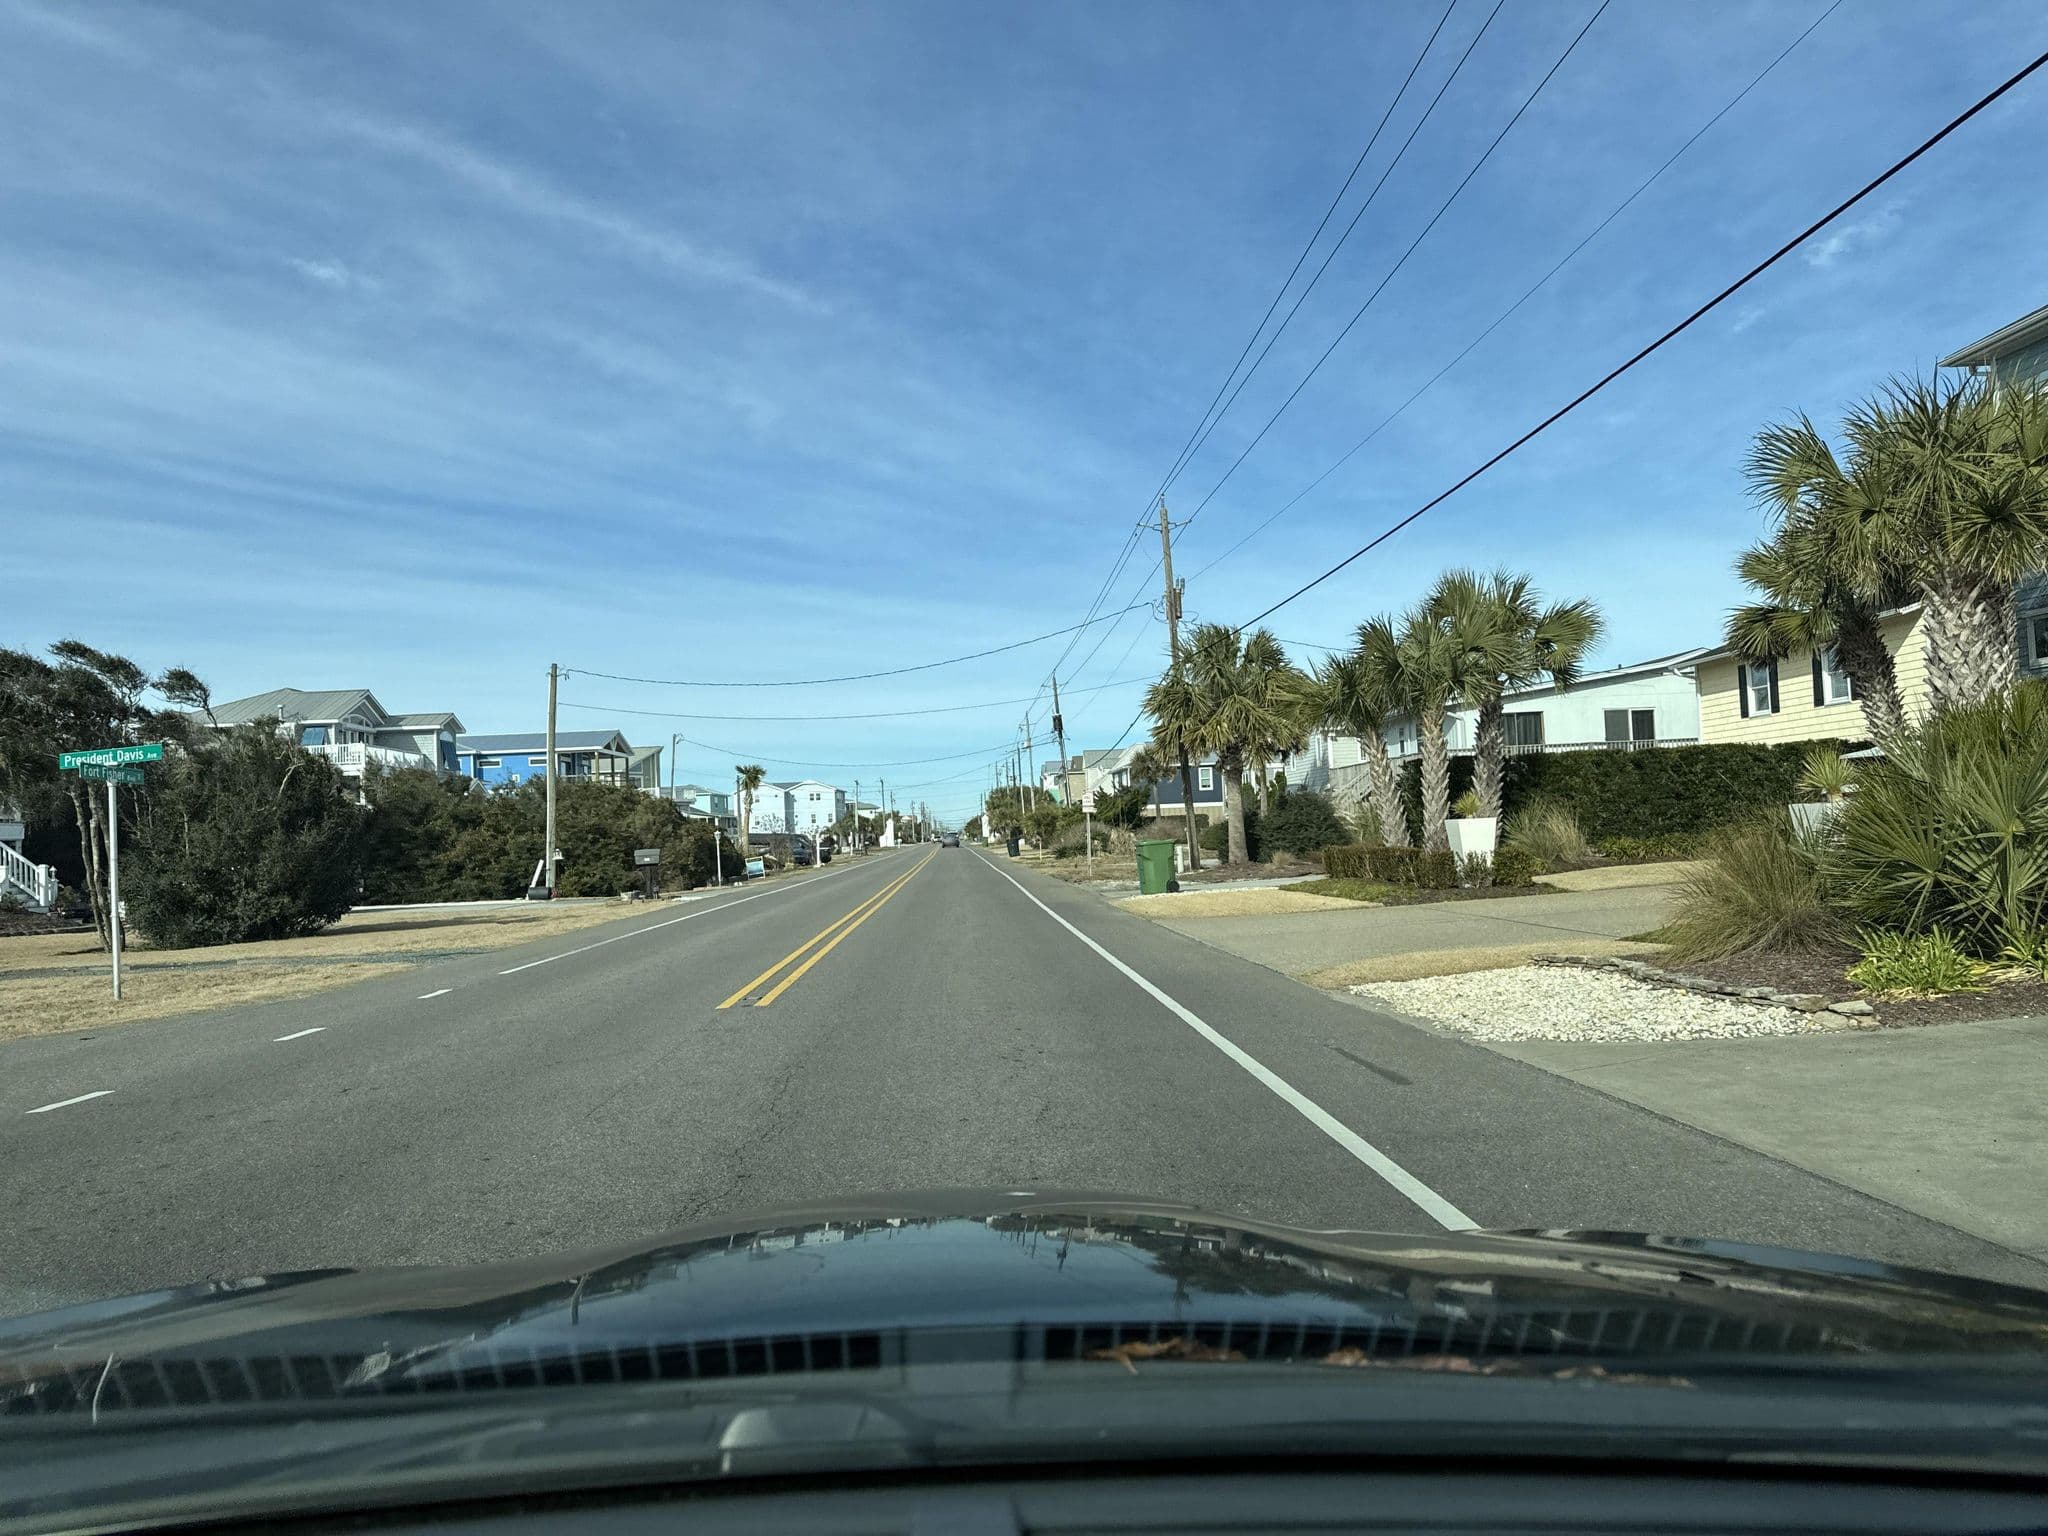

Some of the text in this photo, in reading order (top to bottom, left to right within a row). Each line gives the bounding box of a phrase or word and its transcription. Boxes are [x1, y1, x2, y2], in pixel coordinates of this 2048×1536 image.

[64, 751, 113, 767] President
[117, 748, 144, 762] Davis
[83, 765, 99, 778] Fort
[102, 767, 125, 781] Fisher
